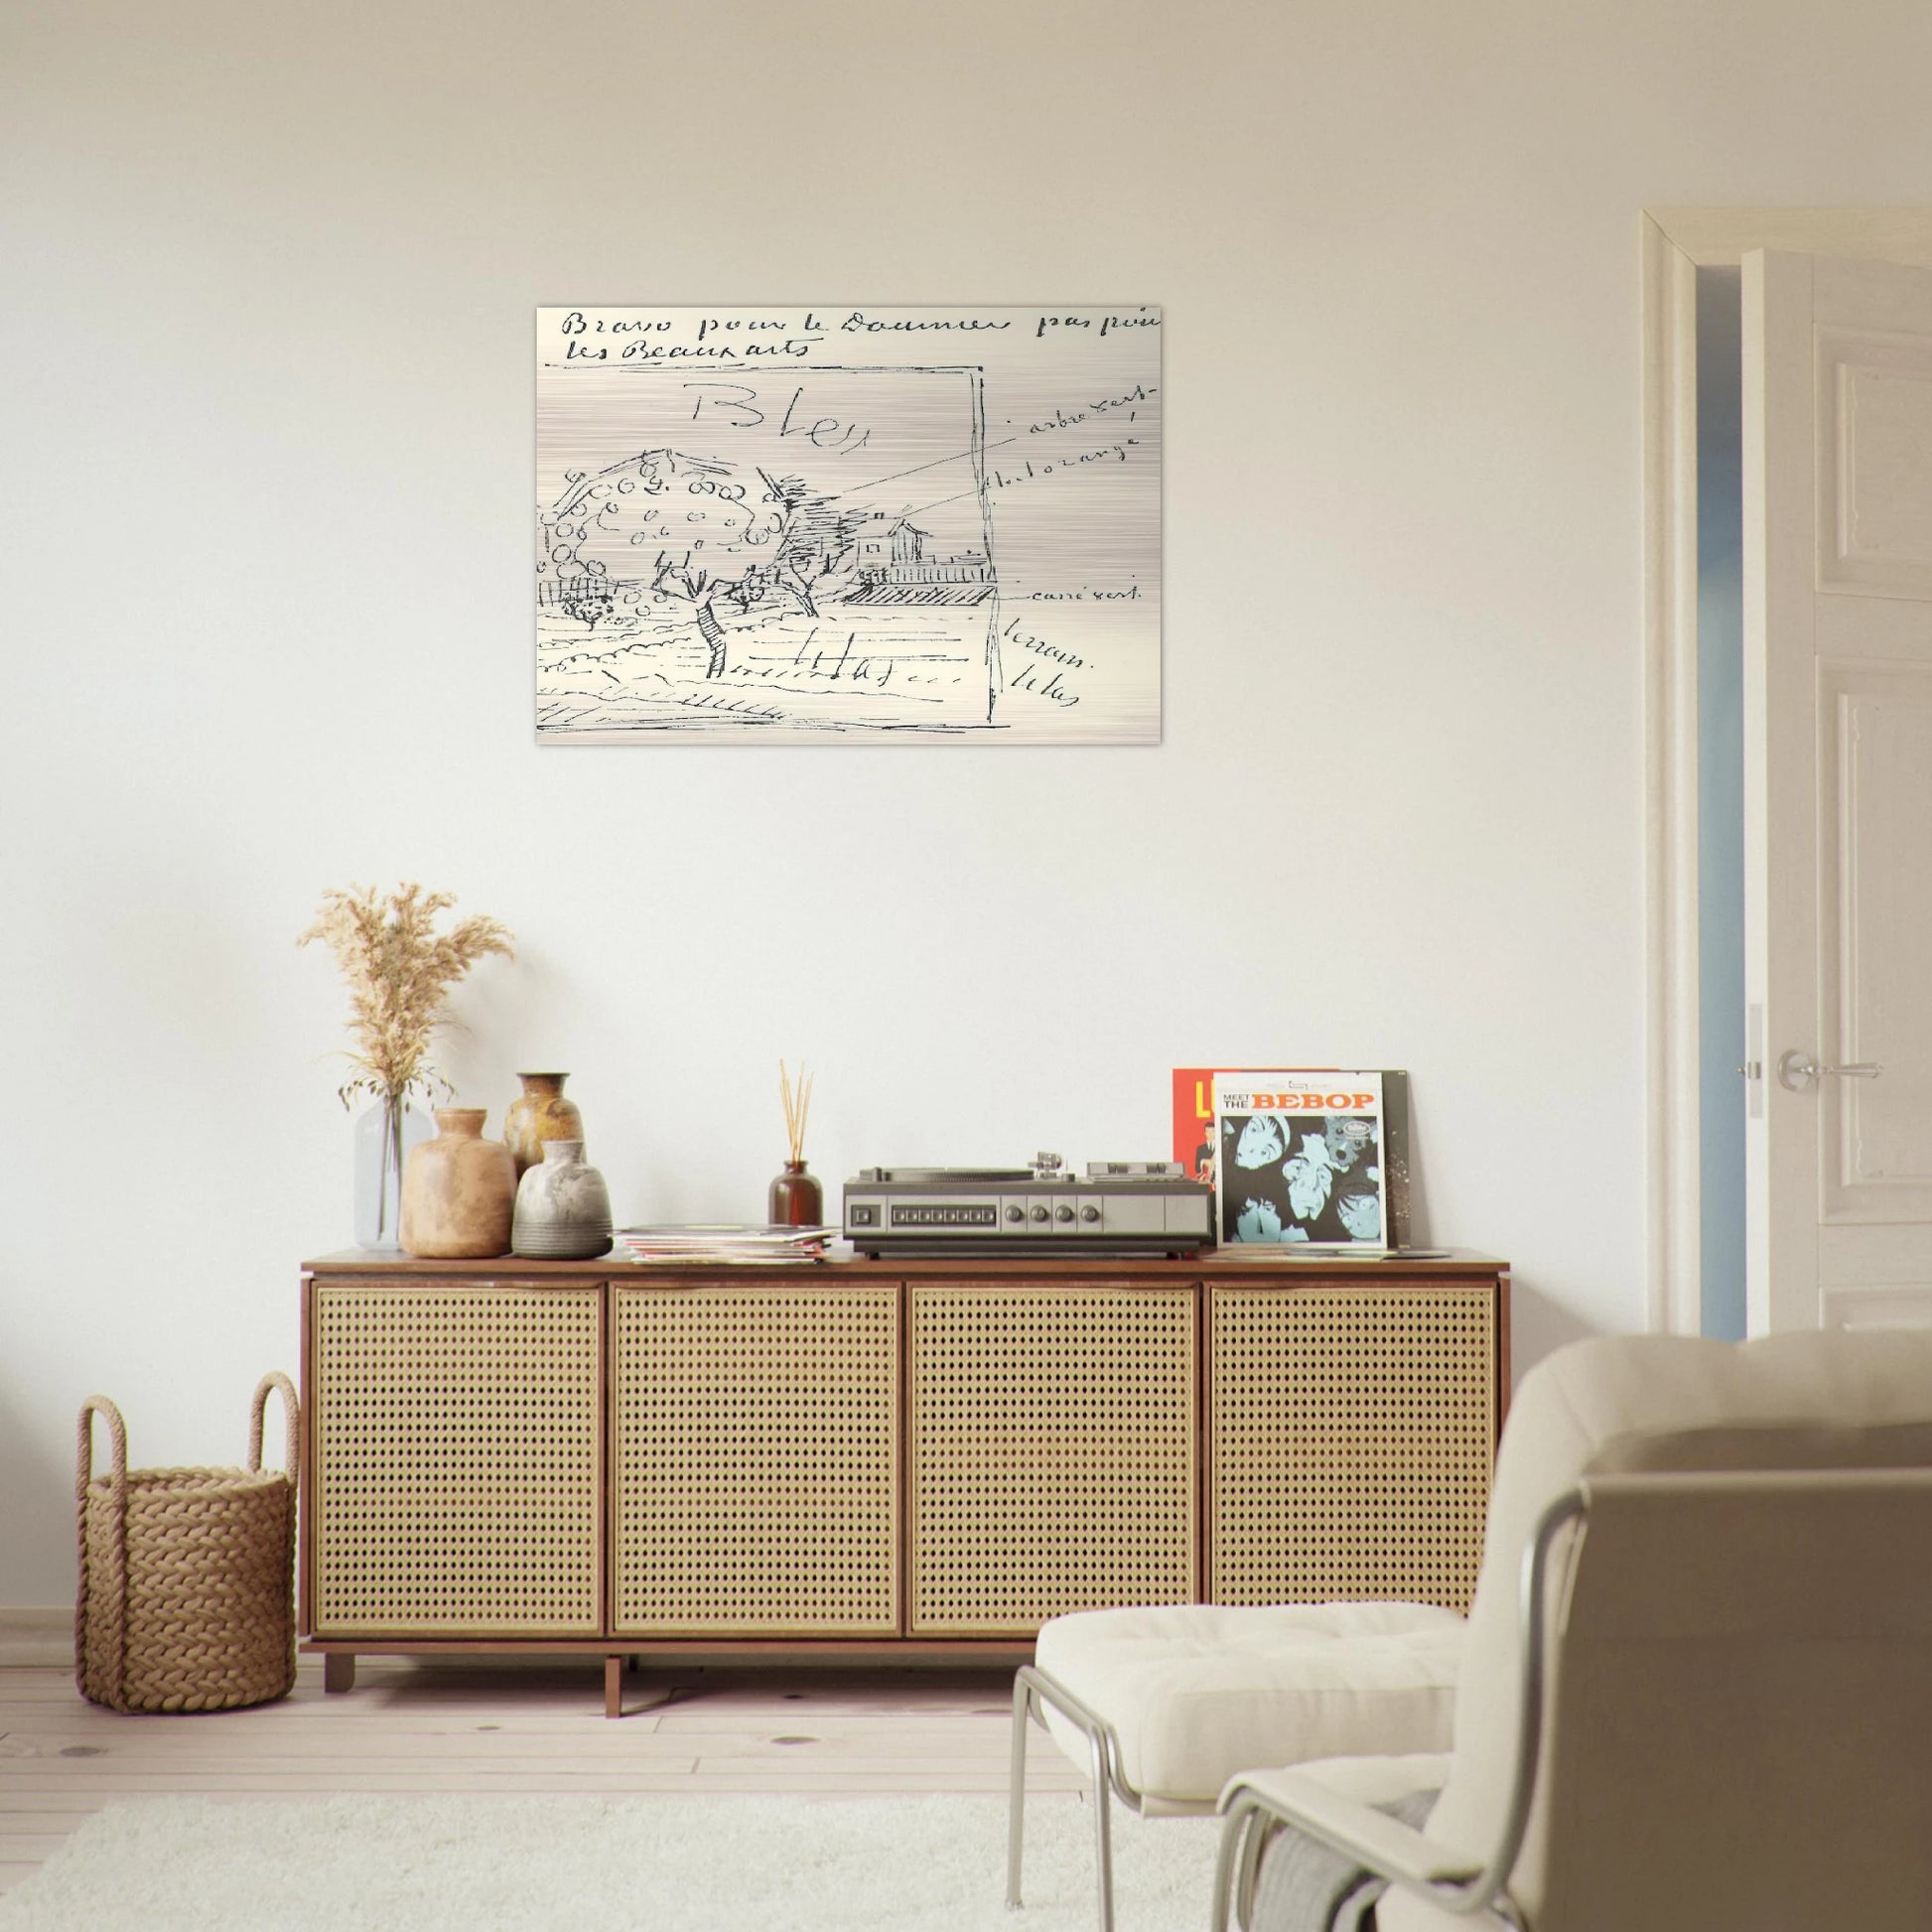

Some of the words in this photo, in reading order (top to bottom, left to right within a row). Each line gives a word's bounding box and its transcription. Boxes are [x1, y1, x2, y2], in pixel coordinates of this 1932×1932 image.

[562, 312, 672, 335] Bravo
[698, 316, 787, 341] pour
[567, 341, 608, 359] les
[1223, 1100, 1248, 1109] THE
[1251, 1093, 1375, 1109] BEBOP
